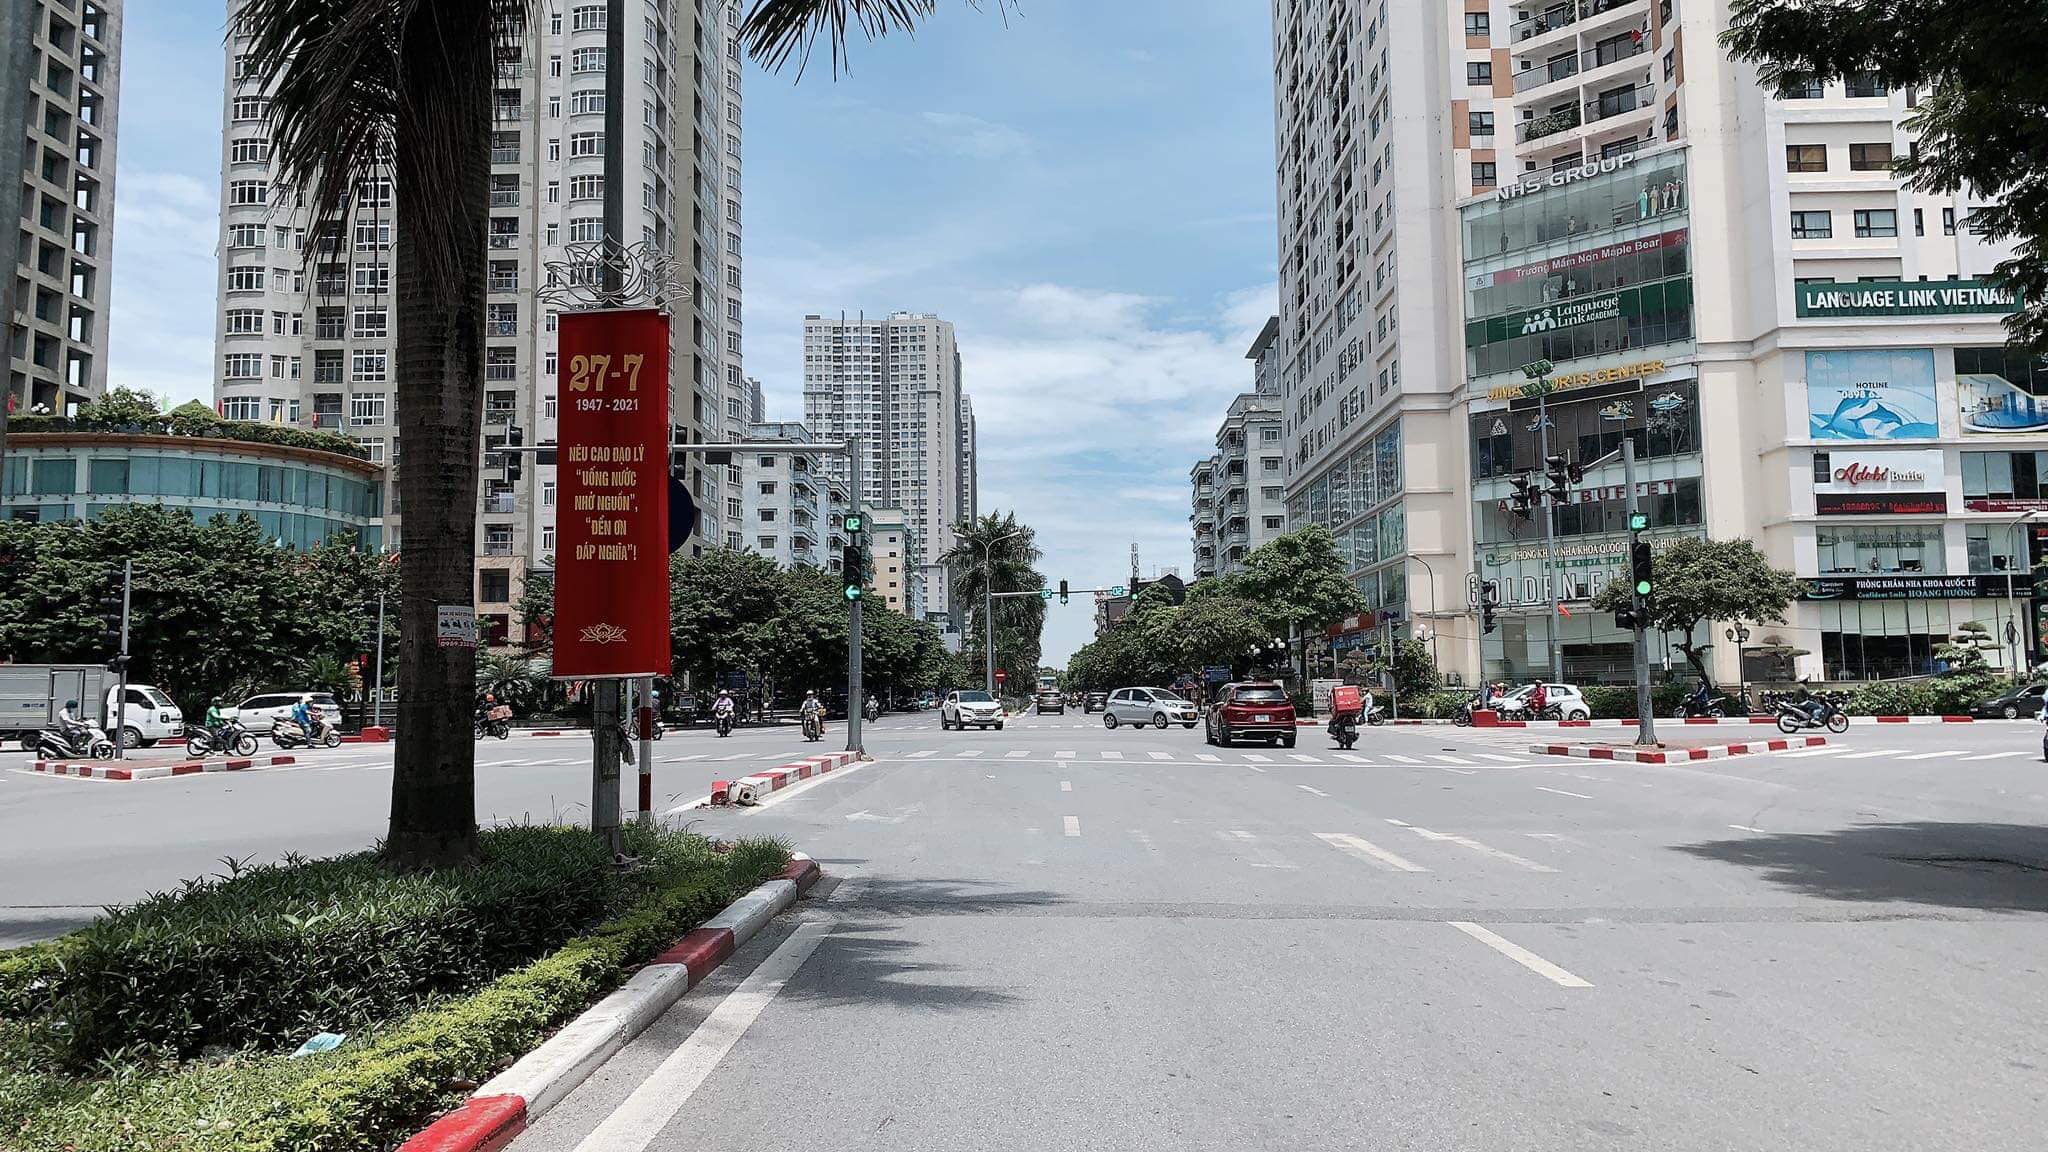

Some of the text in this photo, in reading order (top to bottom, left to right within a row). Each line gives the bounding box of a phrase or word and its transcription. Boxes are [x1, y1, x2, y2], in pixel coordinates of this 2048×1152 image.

[1496, 153, 1635, 202] NHS GROUP
[1578, 253, 1599, 264] Non
[1601, 246, 1632, 260] Maple
[1635, 238, 1660, 251] Bear
[1557, 297, 1619, 317] Language
[1806, 291, 1895, 309] LANGUAGE
[1899, 290, 1938, 308] LINK
[1557, 308, 1620, 328] Link ACADEMIC
[569, 354, 644, 391] 27-7
[1595, 359, 1665, 384] CENTER
[1856, 381, 1889, 389] HOTLINE
[576, 399, 603, 411] 1947
[613, 399, 639, 411] 2021
[569, 443, 645, 465] NÊU CAO ĐẠO LÝ
[611, 467, 637, 486] NƯỚC
[574, 491, 596, 511] NHỚ
[846, 518, 860, 530] 02
[576, 541, 596, 560] ĐÁP
[1112, 587, 1123, 596] 02
[1856, 578, 1881, 588] PHÒNG
[1905, 580, 1921, 588] NHA
[1922, 579, 1944, 588] KHOA
[1041, 590, 1052, 598] 02
